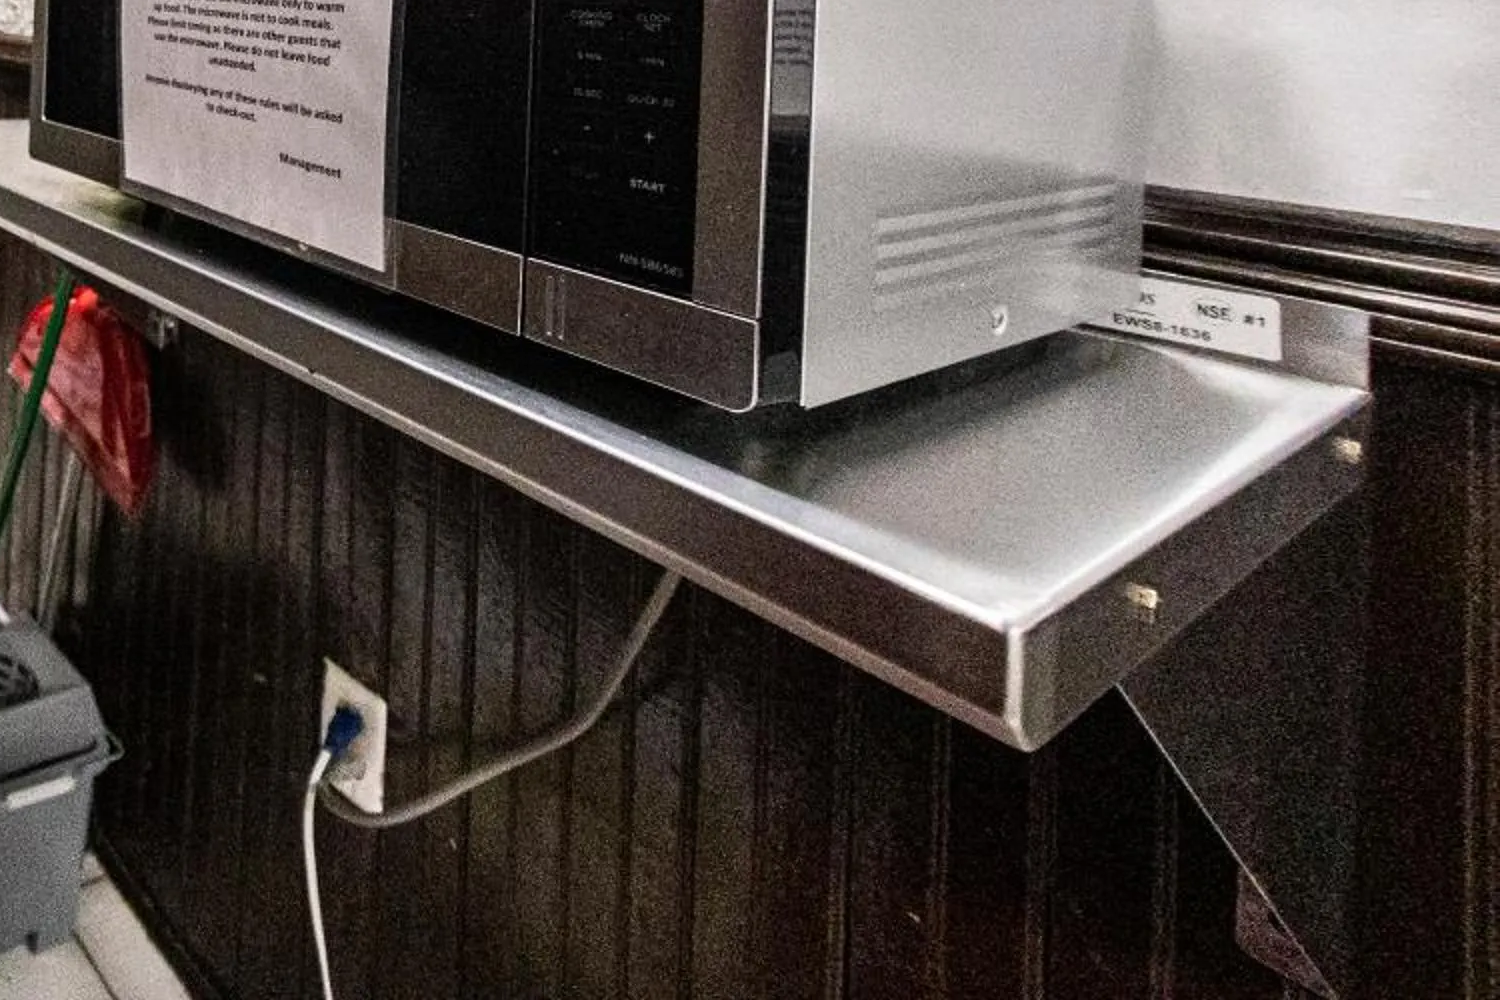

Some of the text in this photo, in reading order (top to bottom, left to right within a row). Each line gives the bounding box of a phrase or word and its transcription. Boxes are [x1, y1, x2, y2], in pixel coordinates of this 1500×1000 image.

[303, 0, 314, 10] to
[267, 14, 277, 24] to
[278, 15, 300, 27] cook
[262, 30, 286, 42] other
[287, 34, 318, 47] guests
[281, 48, 306, 62] leave
[307, 53, 331, 66] food
[314, 110, 343, 124] asked
[279, 152, 341, 179] Management
[629, 177, 666, 194] START
